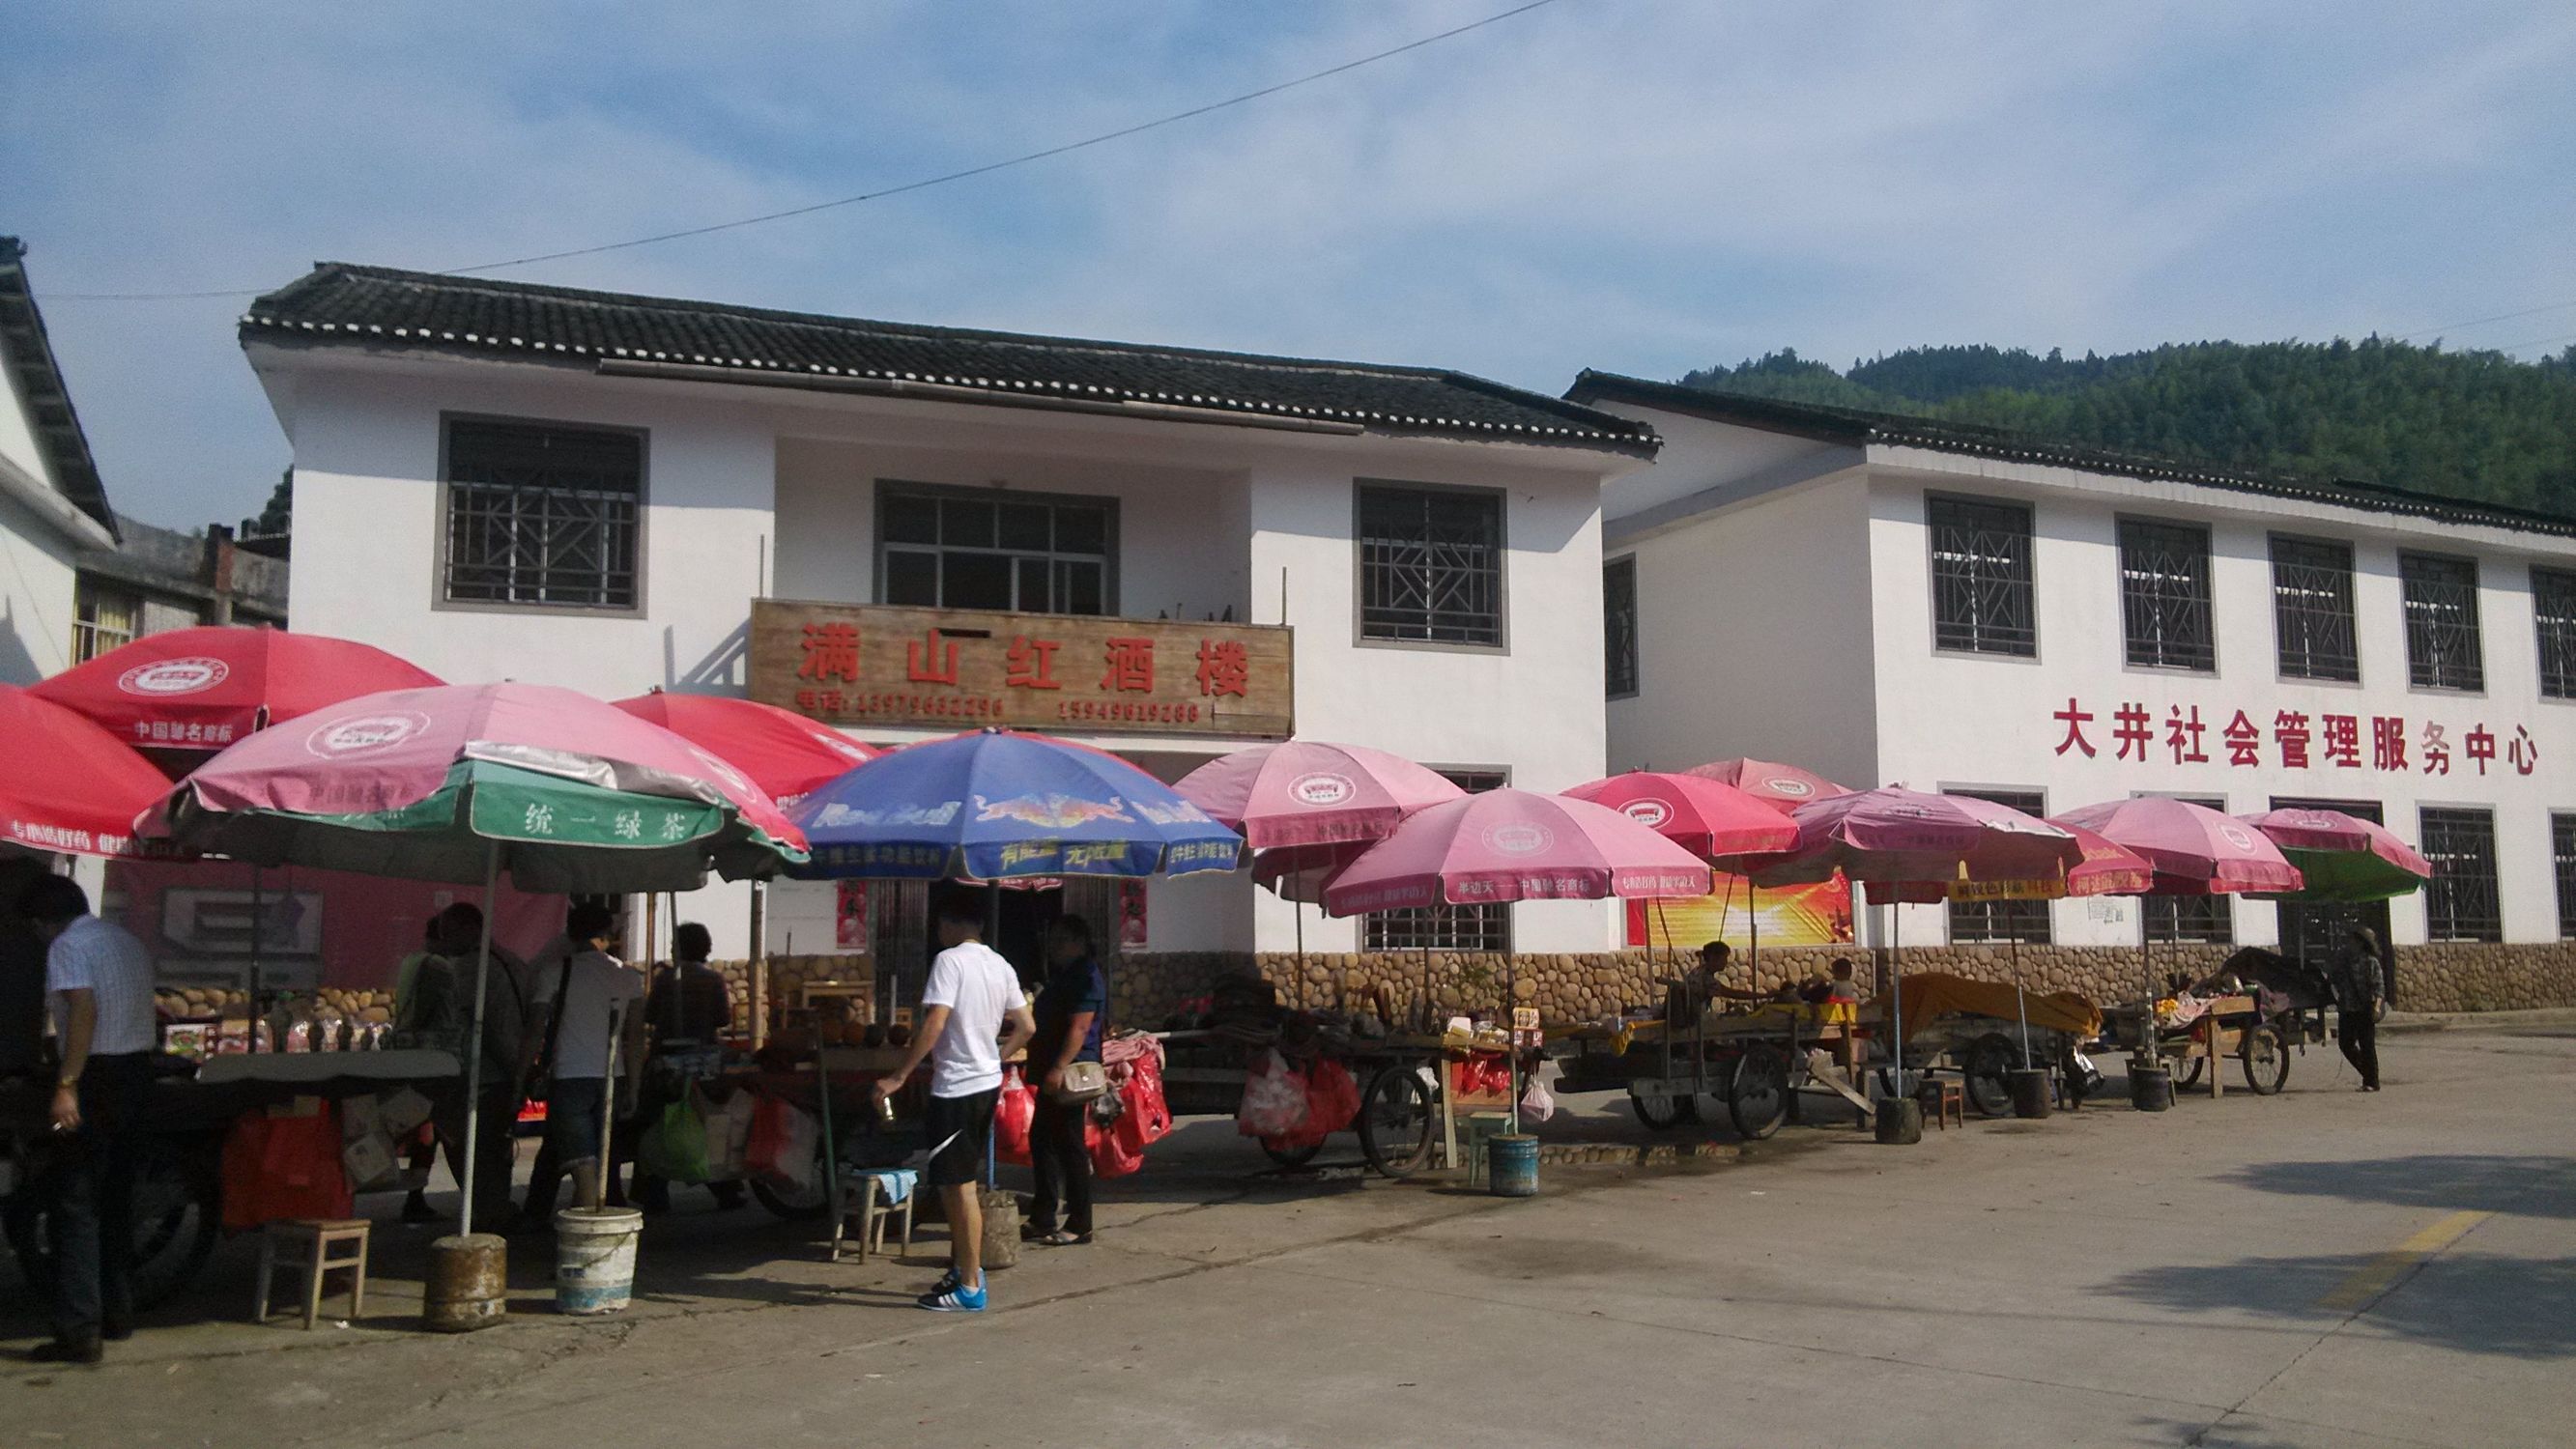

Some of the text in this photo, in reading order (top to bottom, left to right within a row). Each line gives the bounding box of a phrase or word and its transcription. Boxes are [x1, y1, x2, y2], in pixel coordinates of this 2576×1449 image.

[797, 621, 1249, 698] 满山红酒楼
[2052, 696, 2539, 776] 大井社会管理服务中心
[525, 803, 687, 839] 统一绿茶
